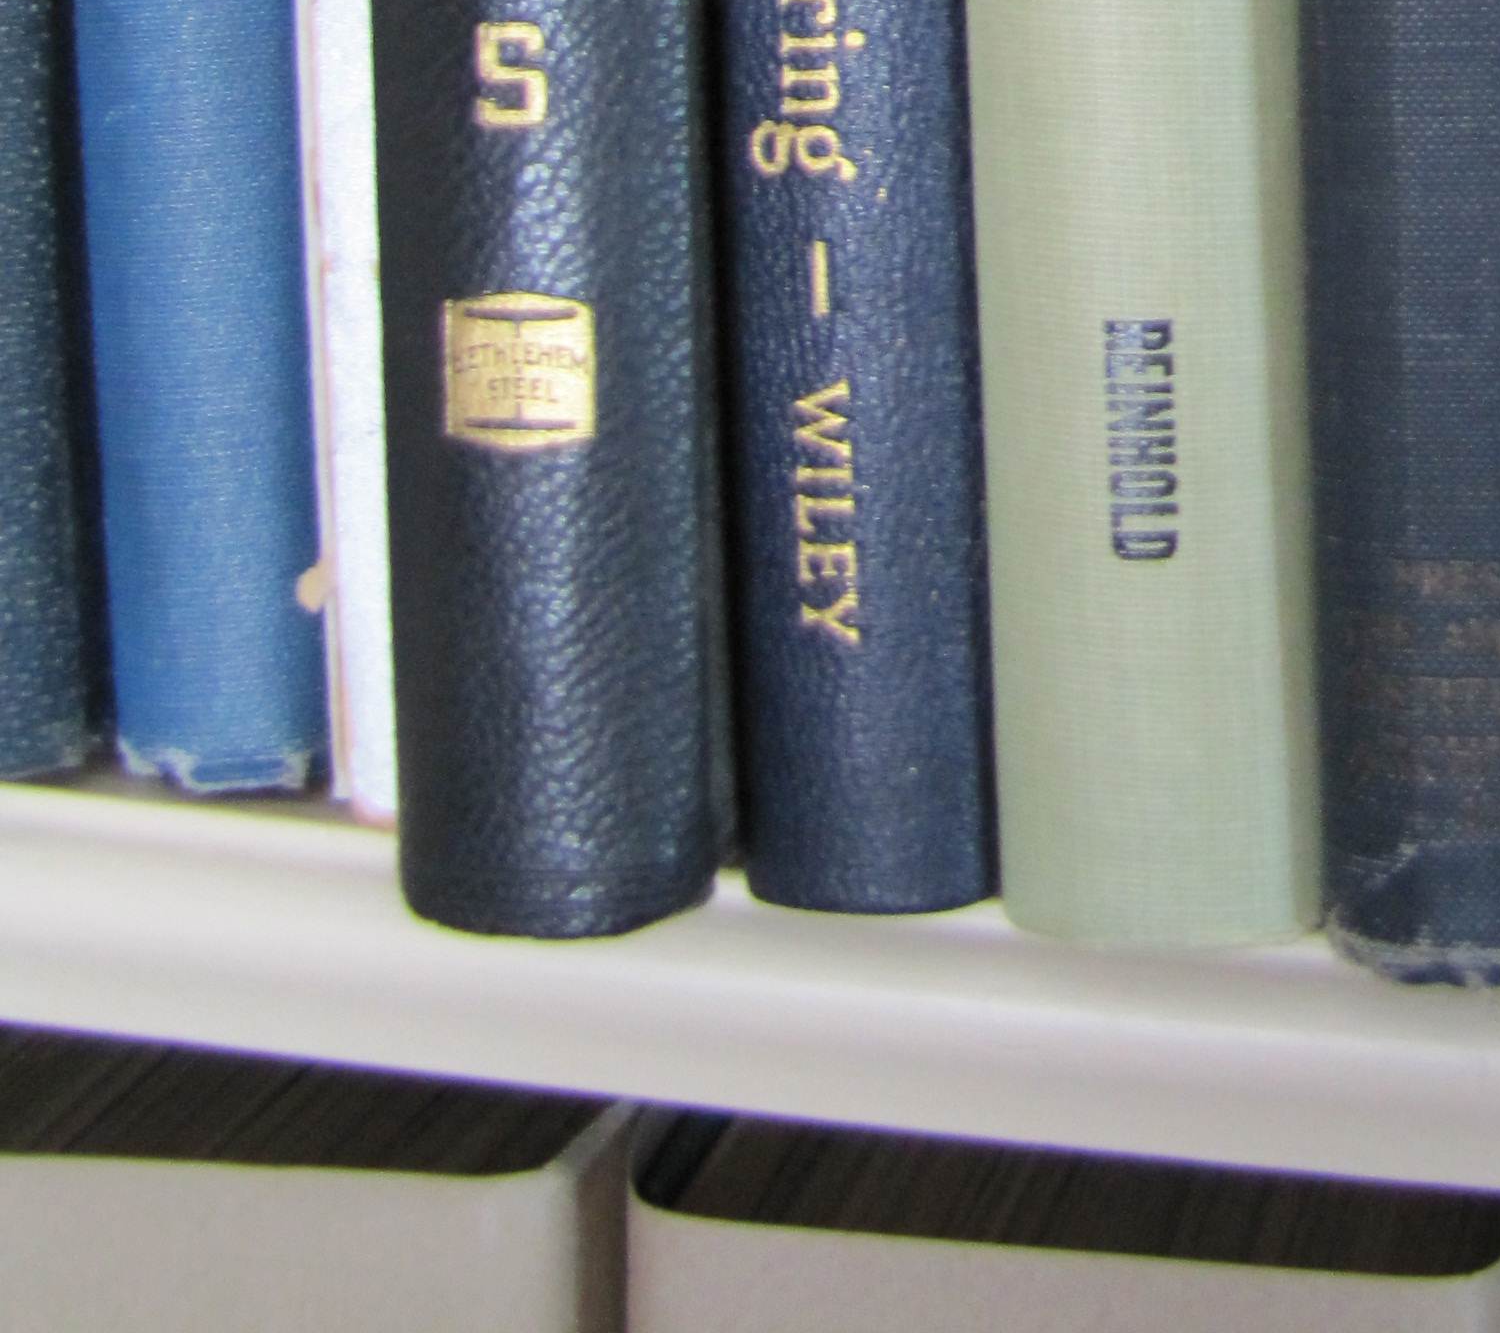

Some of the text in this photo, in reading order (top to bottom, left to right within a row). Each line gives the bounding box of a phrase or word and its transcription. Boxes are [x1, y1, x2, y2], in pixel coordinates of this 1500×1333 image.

[488, 376, 559, 403] STEEL
[1103, 319, 1179, 560] REINHOLD
[791, 380, 861, 643] WILEY
